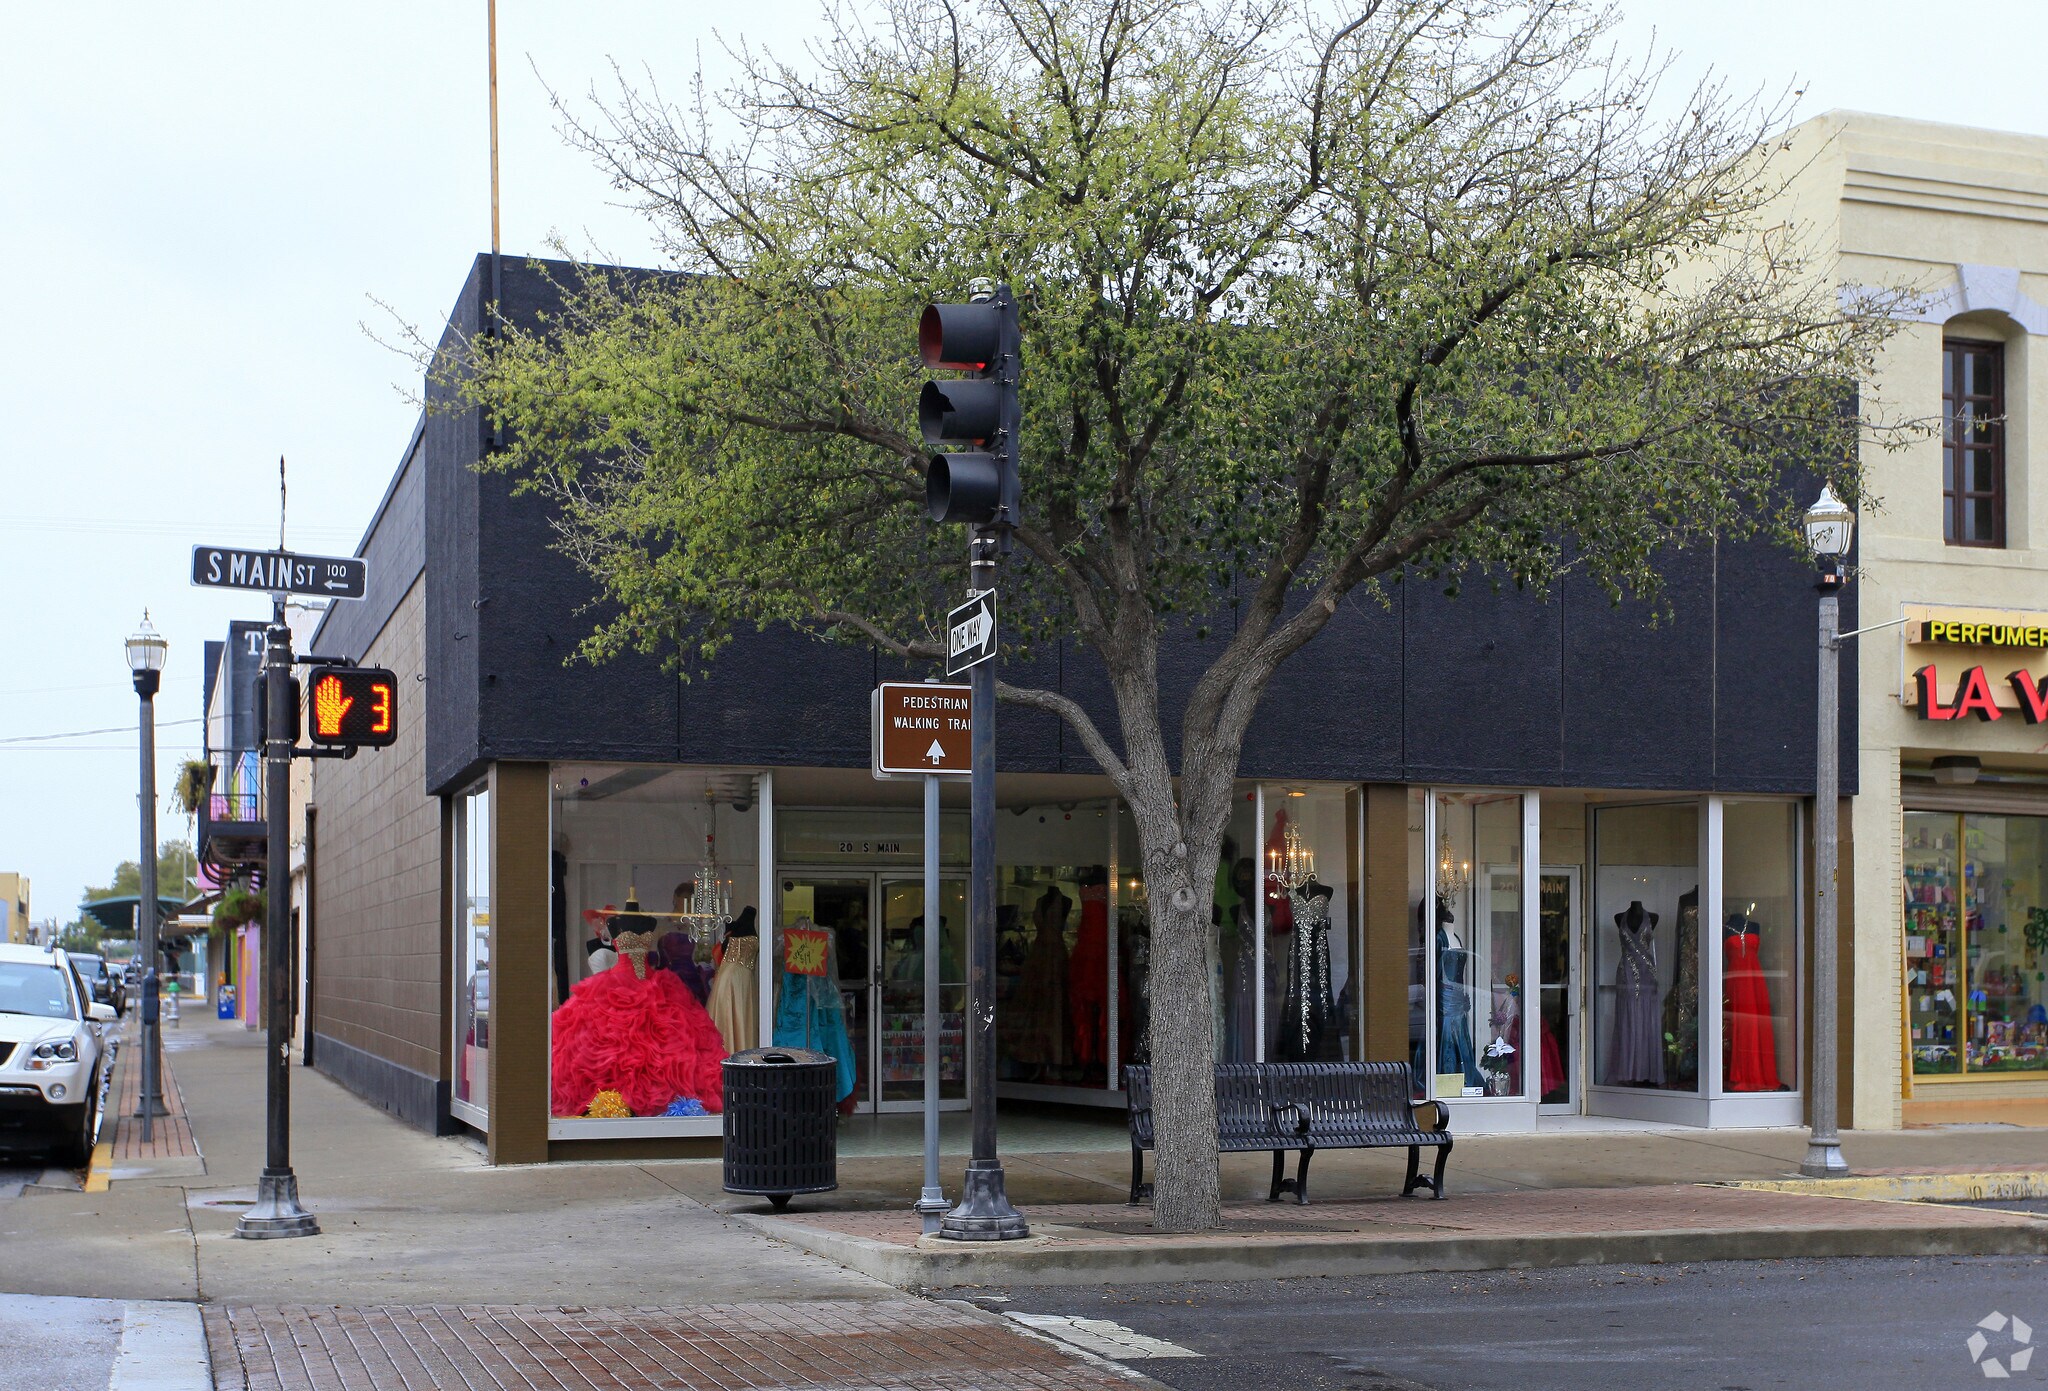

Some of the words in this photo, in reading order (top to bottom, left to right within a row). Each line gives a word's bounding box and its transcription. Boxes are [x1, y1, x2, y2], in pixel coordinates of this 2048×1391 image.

[207, 551, 223, 583] S
[229, 553, 293, 588] MAIN
[295, 564, 316, 586] ST
[327, 564, 347, 578] 100
[952, 626, 965, 653] ONE
[967, 617, 981, 646] WAY
[372, 684, 392, 733] 3
[903, 696, 968, 710] PEDESTRIAN
[1920, 664, 2003, 721] LA
[893, 716, 940, 730] WALKING
[947, 718, 971, 731] TRAI
[840, 842, 853, 853] 20
[863, 842, 869, 853] S
[877, 843, 900, 853] MAIN
